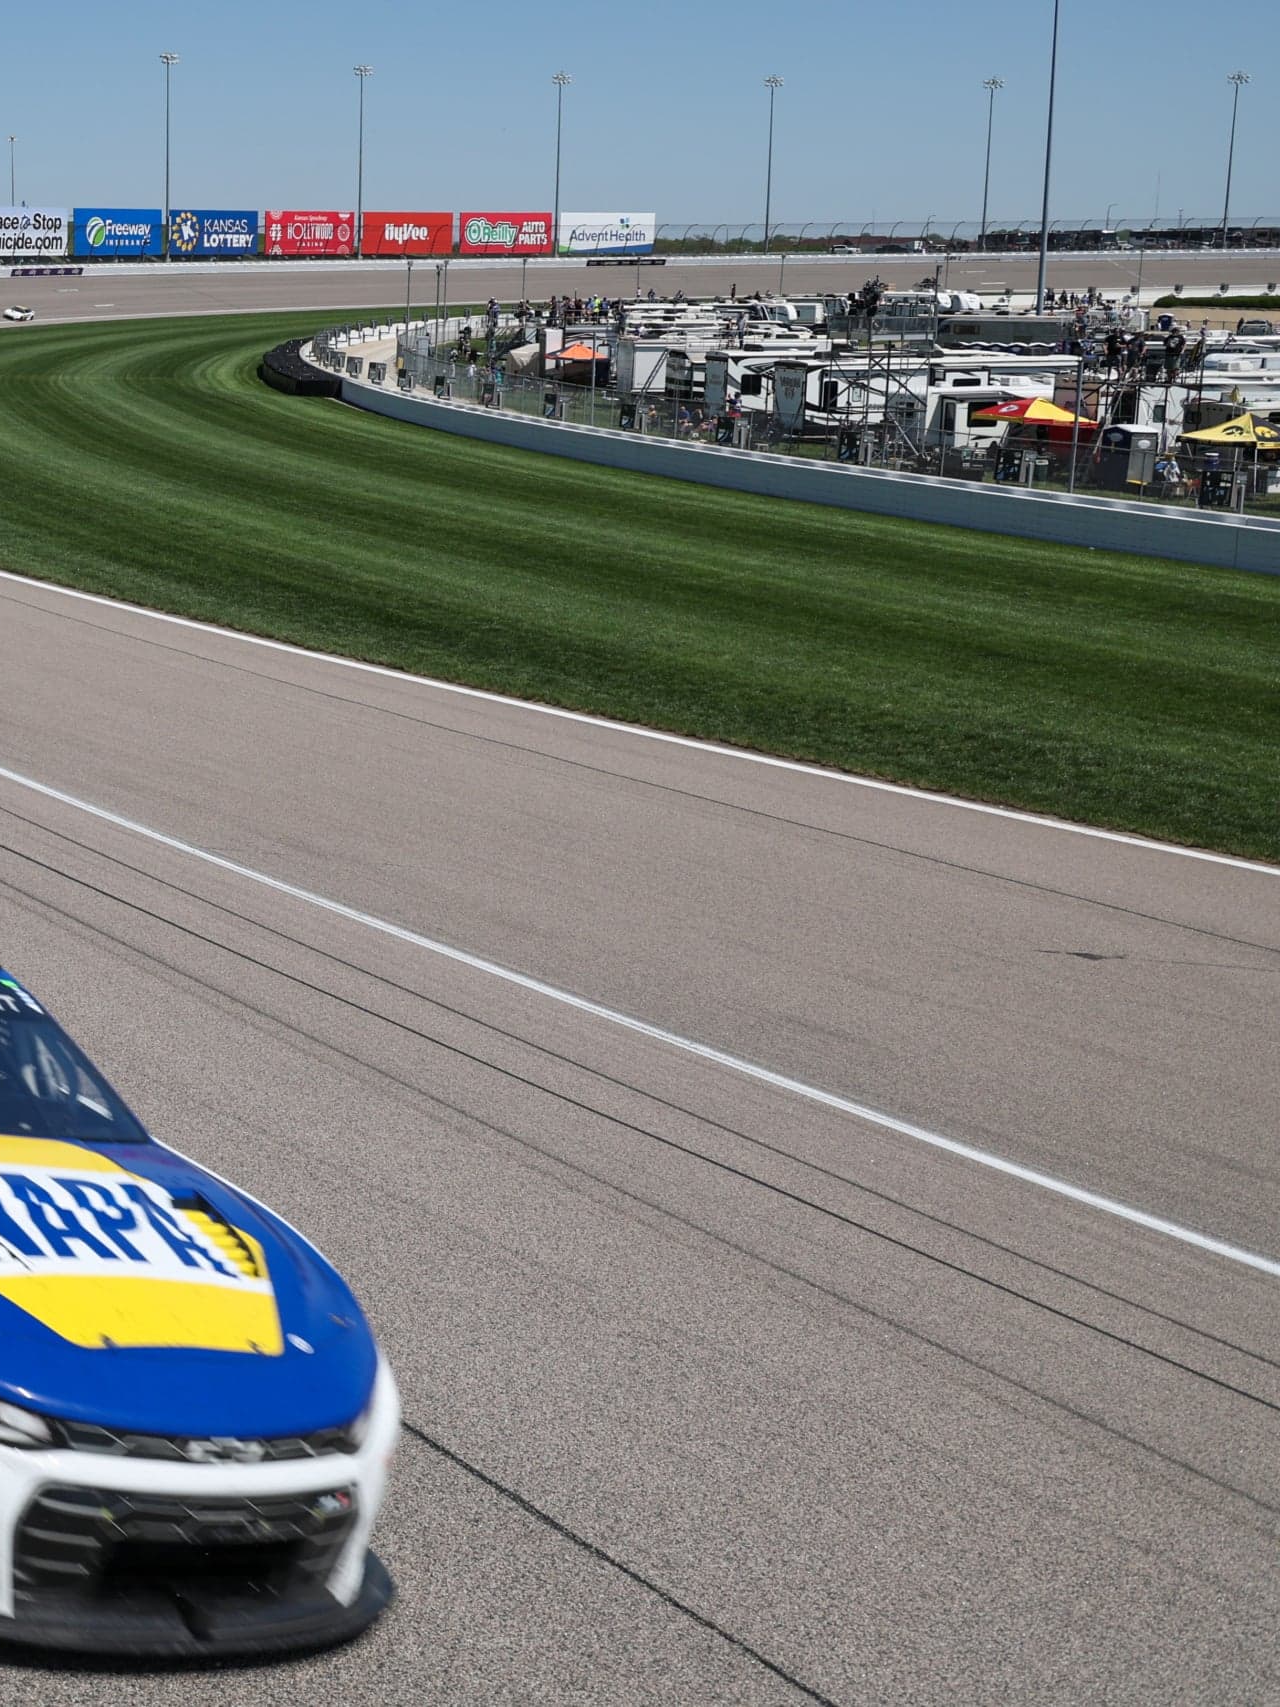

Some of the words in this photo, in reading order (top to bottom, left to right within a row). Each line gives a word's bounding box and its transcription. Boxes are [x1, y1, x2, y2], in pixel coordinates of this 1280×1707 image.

[33, 213, 62, 233] Stop
[106, 220, 151, 236] Freeway
[204, 219, 248, 233] KANSAS
[522, 221, 546, 232] AUTO
[287, 222, 334, 240] HOLLYWOOD
[467, 219, 518, 246] O'Reilly
[204, 234, 255, 248] LOTTERY
[519, 233, 548, 246] PARTS
